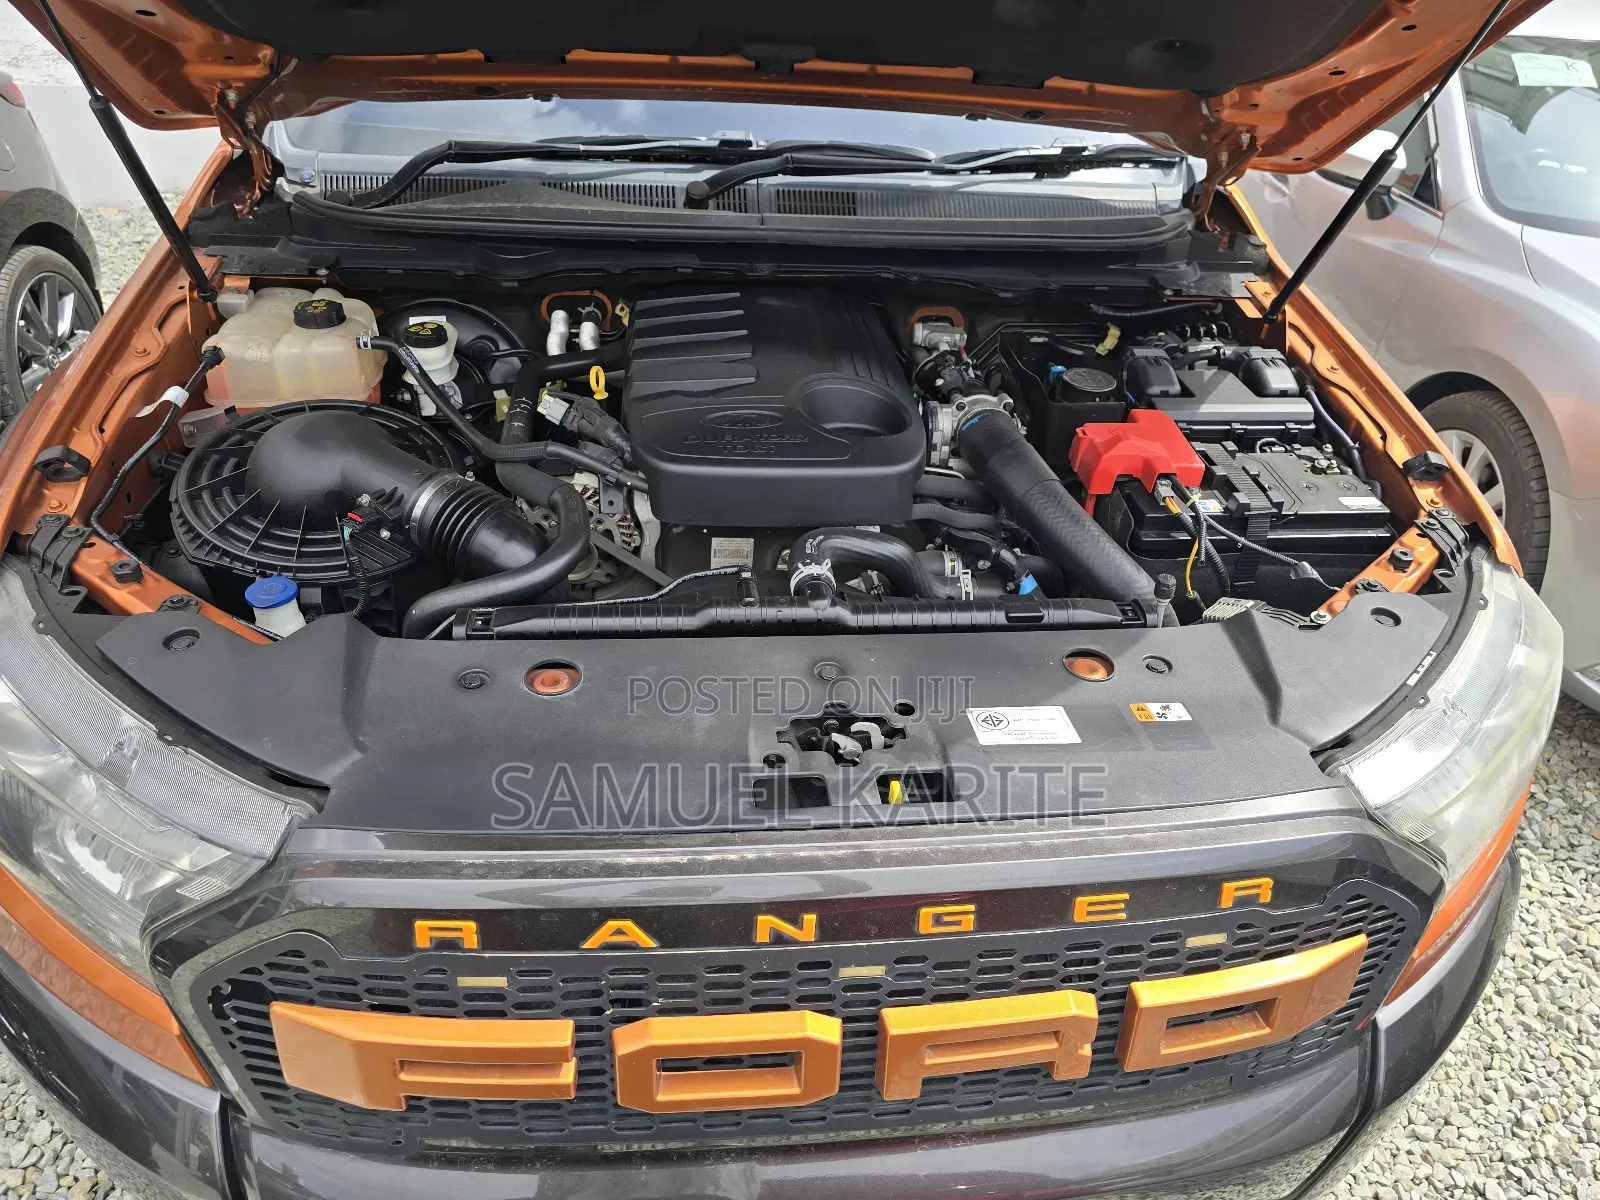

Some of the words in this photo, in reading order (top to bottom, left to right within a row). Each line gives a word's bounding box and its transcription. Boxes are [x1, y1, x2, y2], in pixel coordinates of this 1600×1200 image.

[684, 434, 809, 444] DURATORQ
[413, 876, 1275, 950] RANGER
[269, 933, 1369, 1113] FORD
